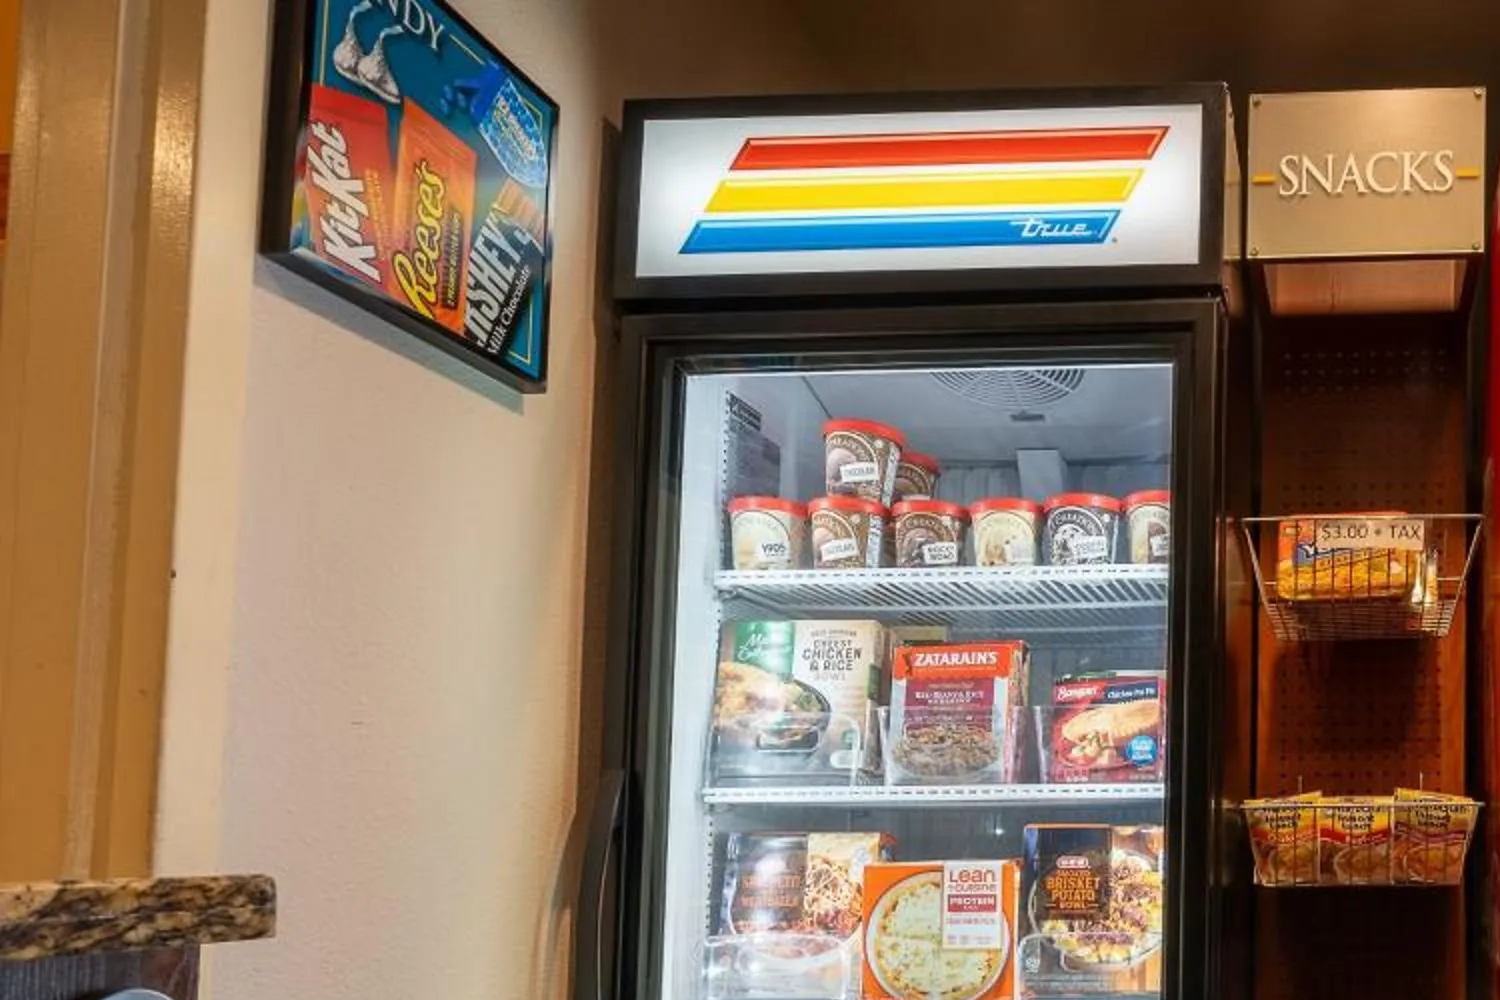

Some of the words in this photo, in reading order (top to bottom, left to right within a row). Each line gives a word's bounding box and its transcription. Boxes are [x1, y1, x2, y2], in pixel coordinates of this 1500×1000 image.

[1277, 148, 1455, 197] SNACKS
[1321, 524, 1368, 539] $3.00
[1389, 525, 1422, 539] TAX
[802, 648, 862, 660] CHICKEN
[823, 660, 853, 671] RICE
[949, 868, 996, 883] Lean
[1046, 877, 1100, 889] BRISKET
[1051, 889, 1095, 900] POTATO
